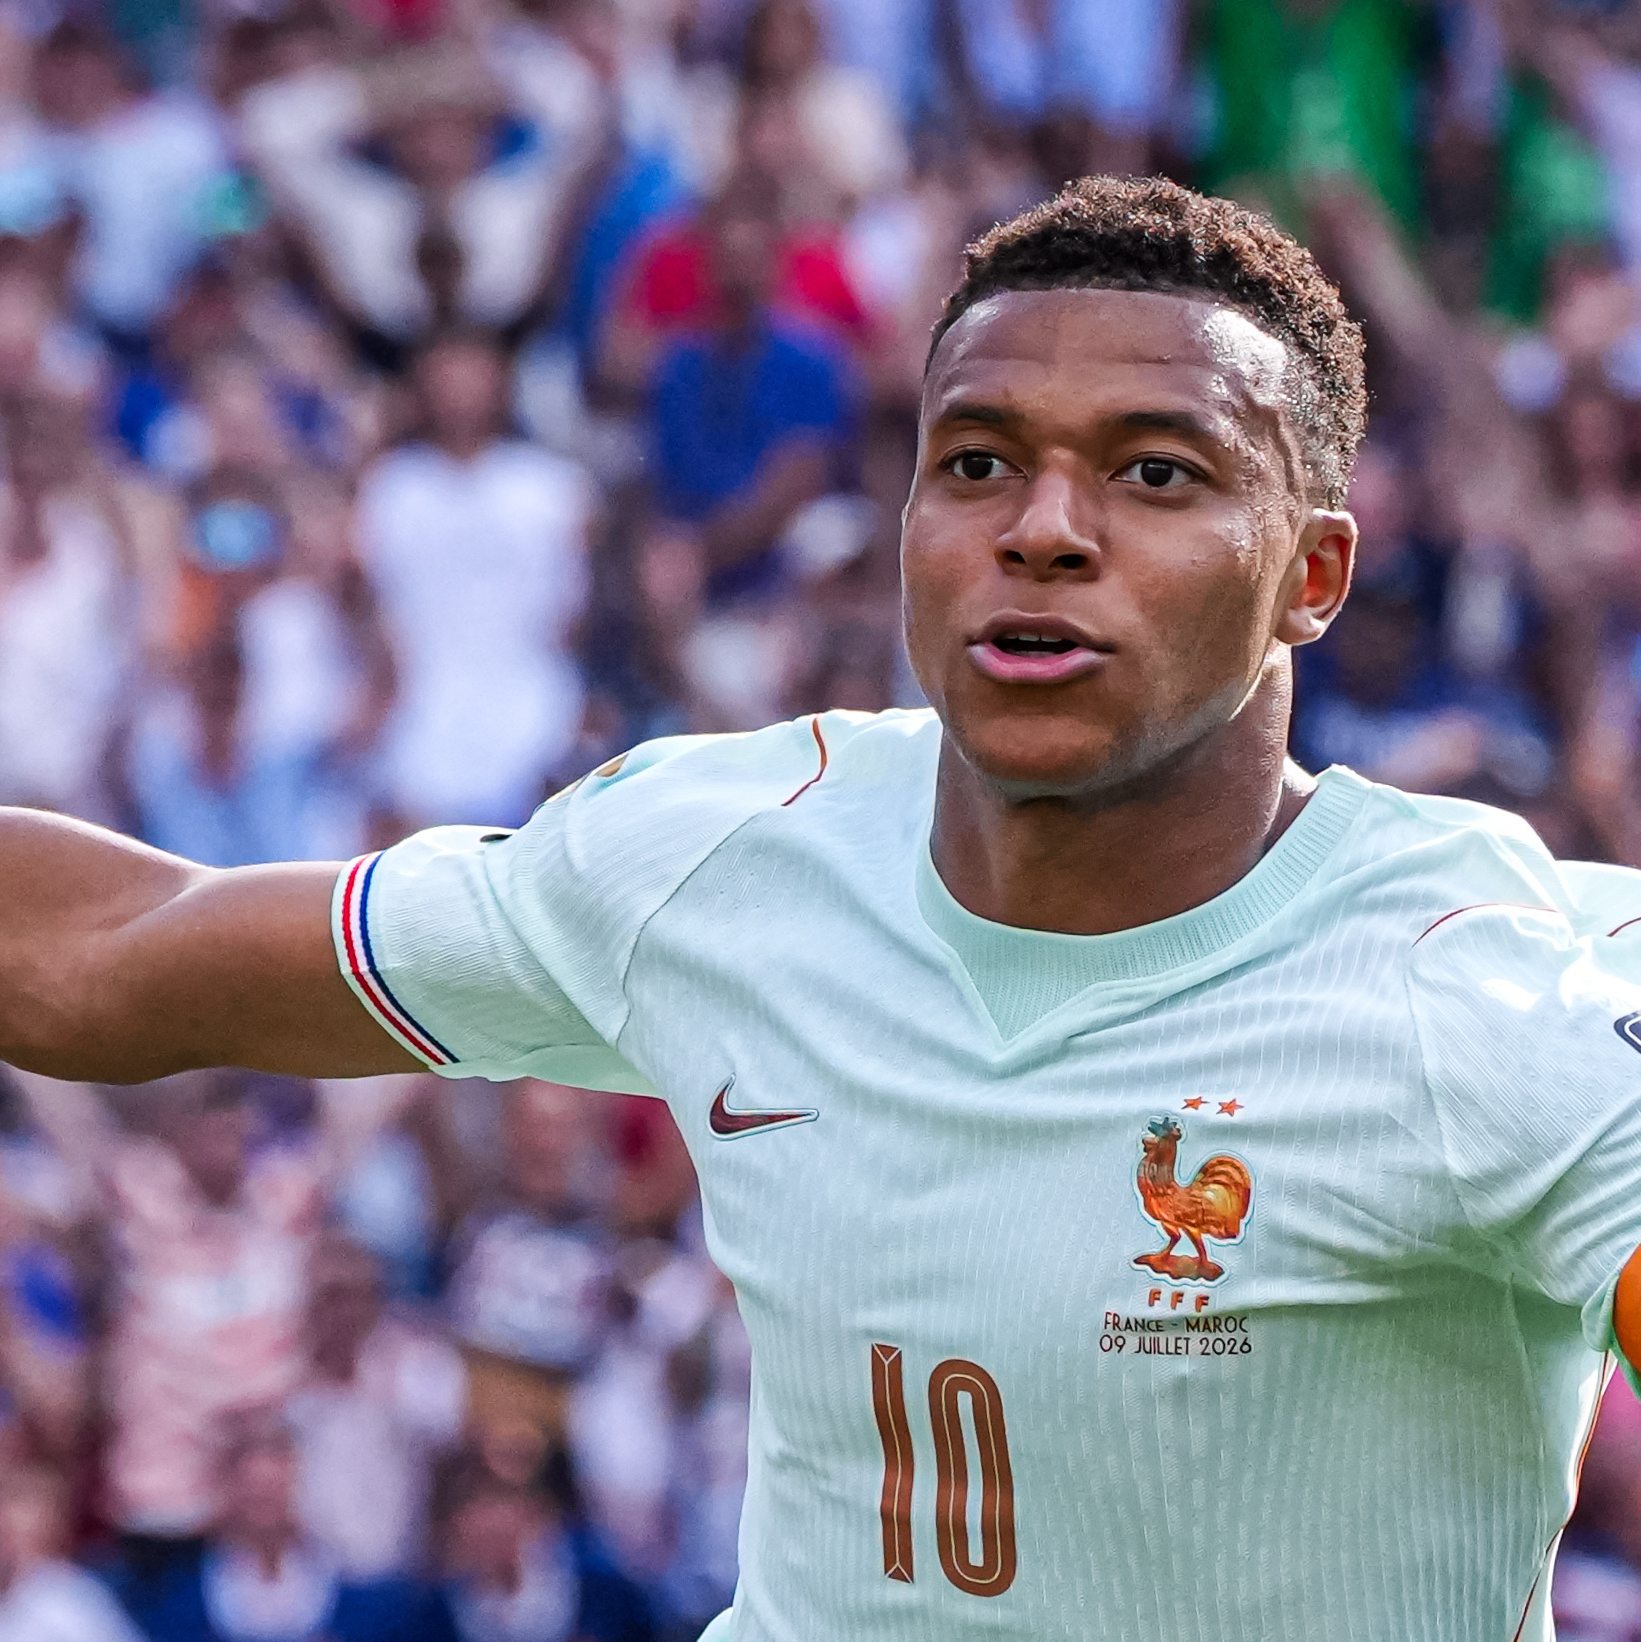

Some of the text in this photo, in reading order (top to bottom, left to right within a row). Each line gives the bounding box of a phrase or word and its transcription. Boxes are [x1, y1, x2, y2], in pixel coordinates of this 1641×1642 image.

[1104, 1312, 1164, 1332] FRANCE
[1185, 1316, 1248, 1333] MAROC
[1100, 1334, 1252, 1355] 09 JUILLET 2026
[871, 1343, 1017, 1597] 10
